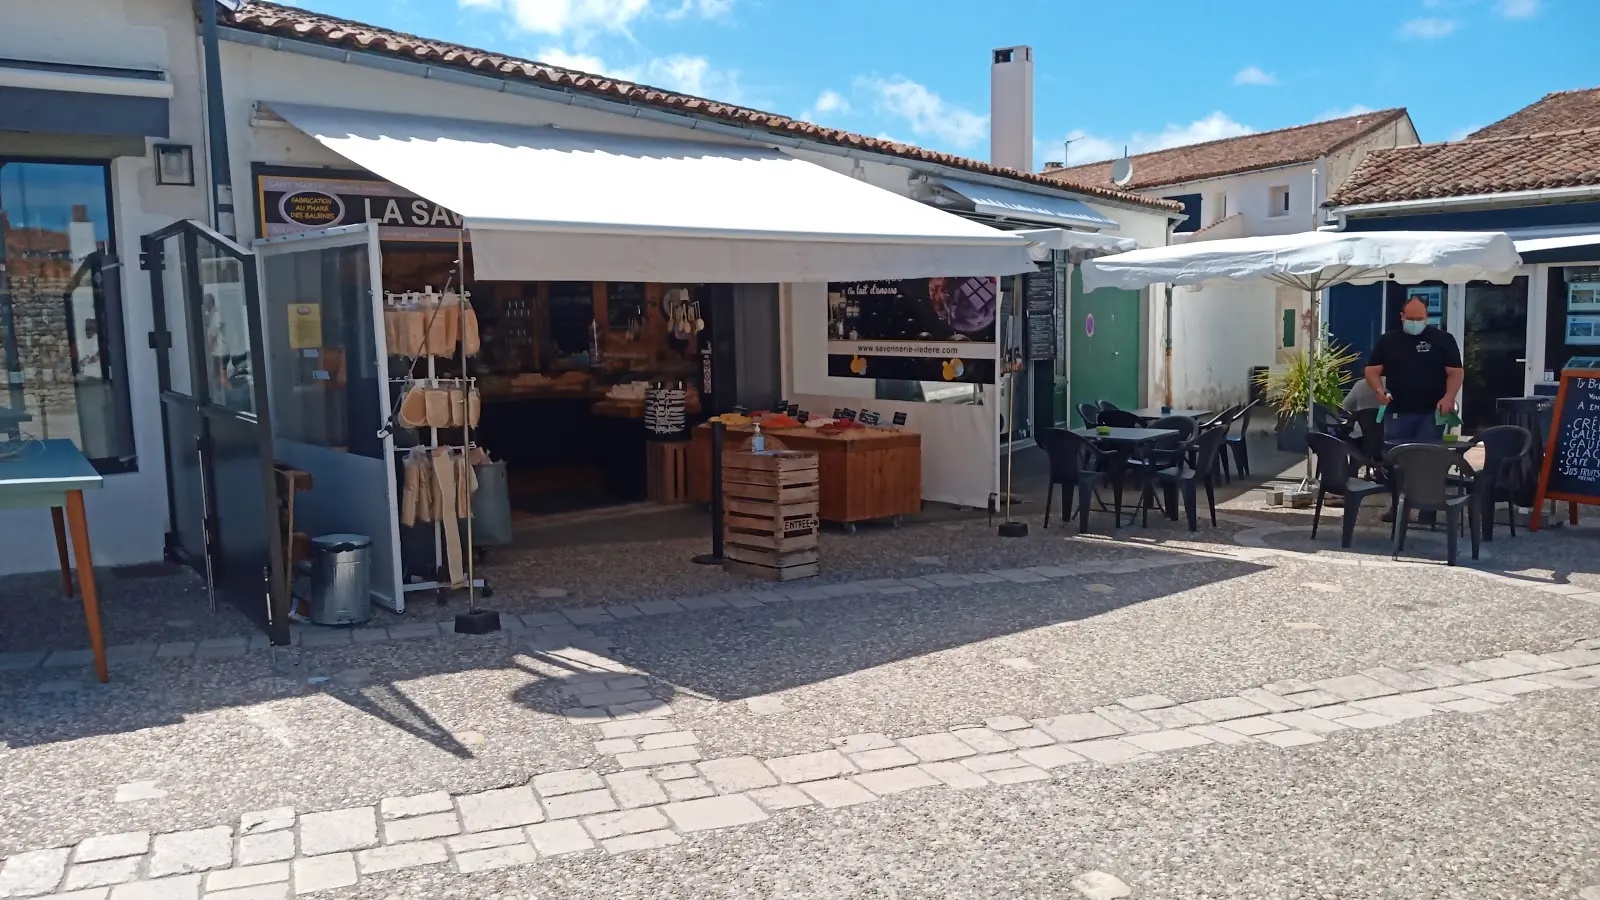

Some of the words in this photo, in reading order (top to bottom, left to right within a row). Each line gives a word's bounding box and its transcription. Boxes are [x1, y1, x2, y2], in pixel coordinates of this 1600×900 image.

[364, 197, 404, 224] LA
[856, 283, 868, 295] lait
[1577, 377, 1586, 389] Ty
[1577, 401, 1585, 410] A
[1565, 457, 1588, 467] CAFÉ
[1562, 466, 1578, 476] JUS
